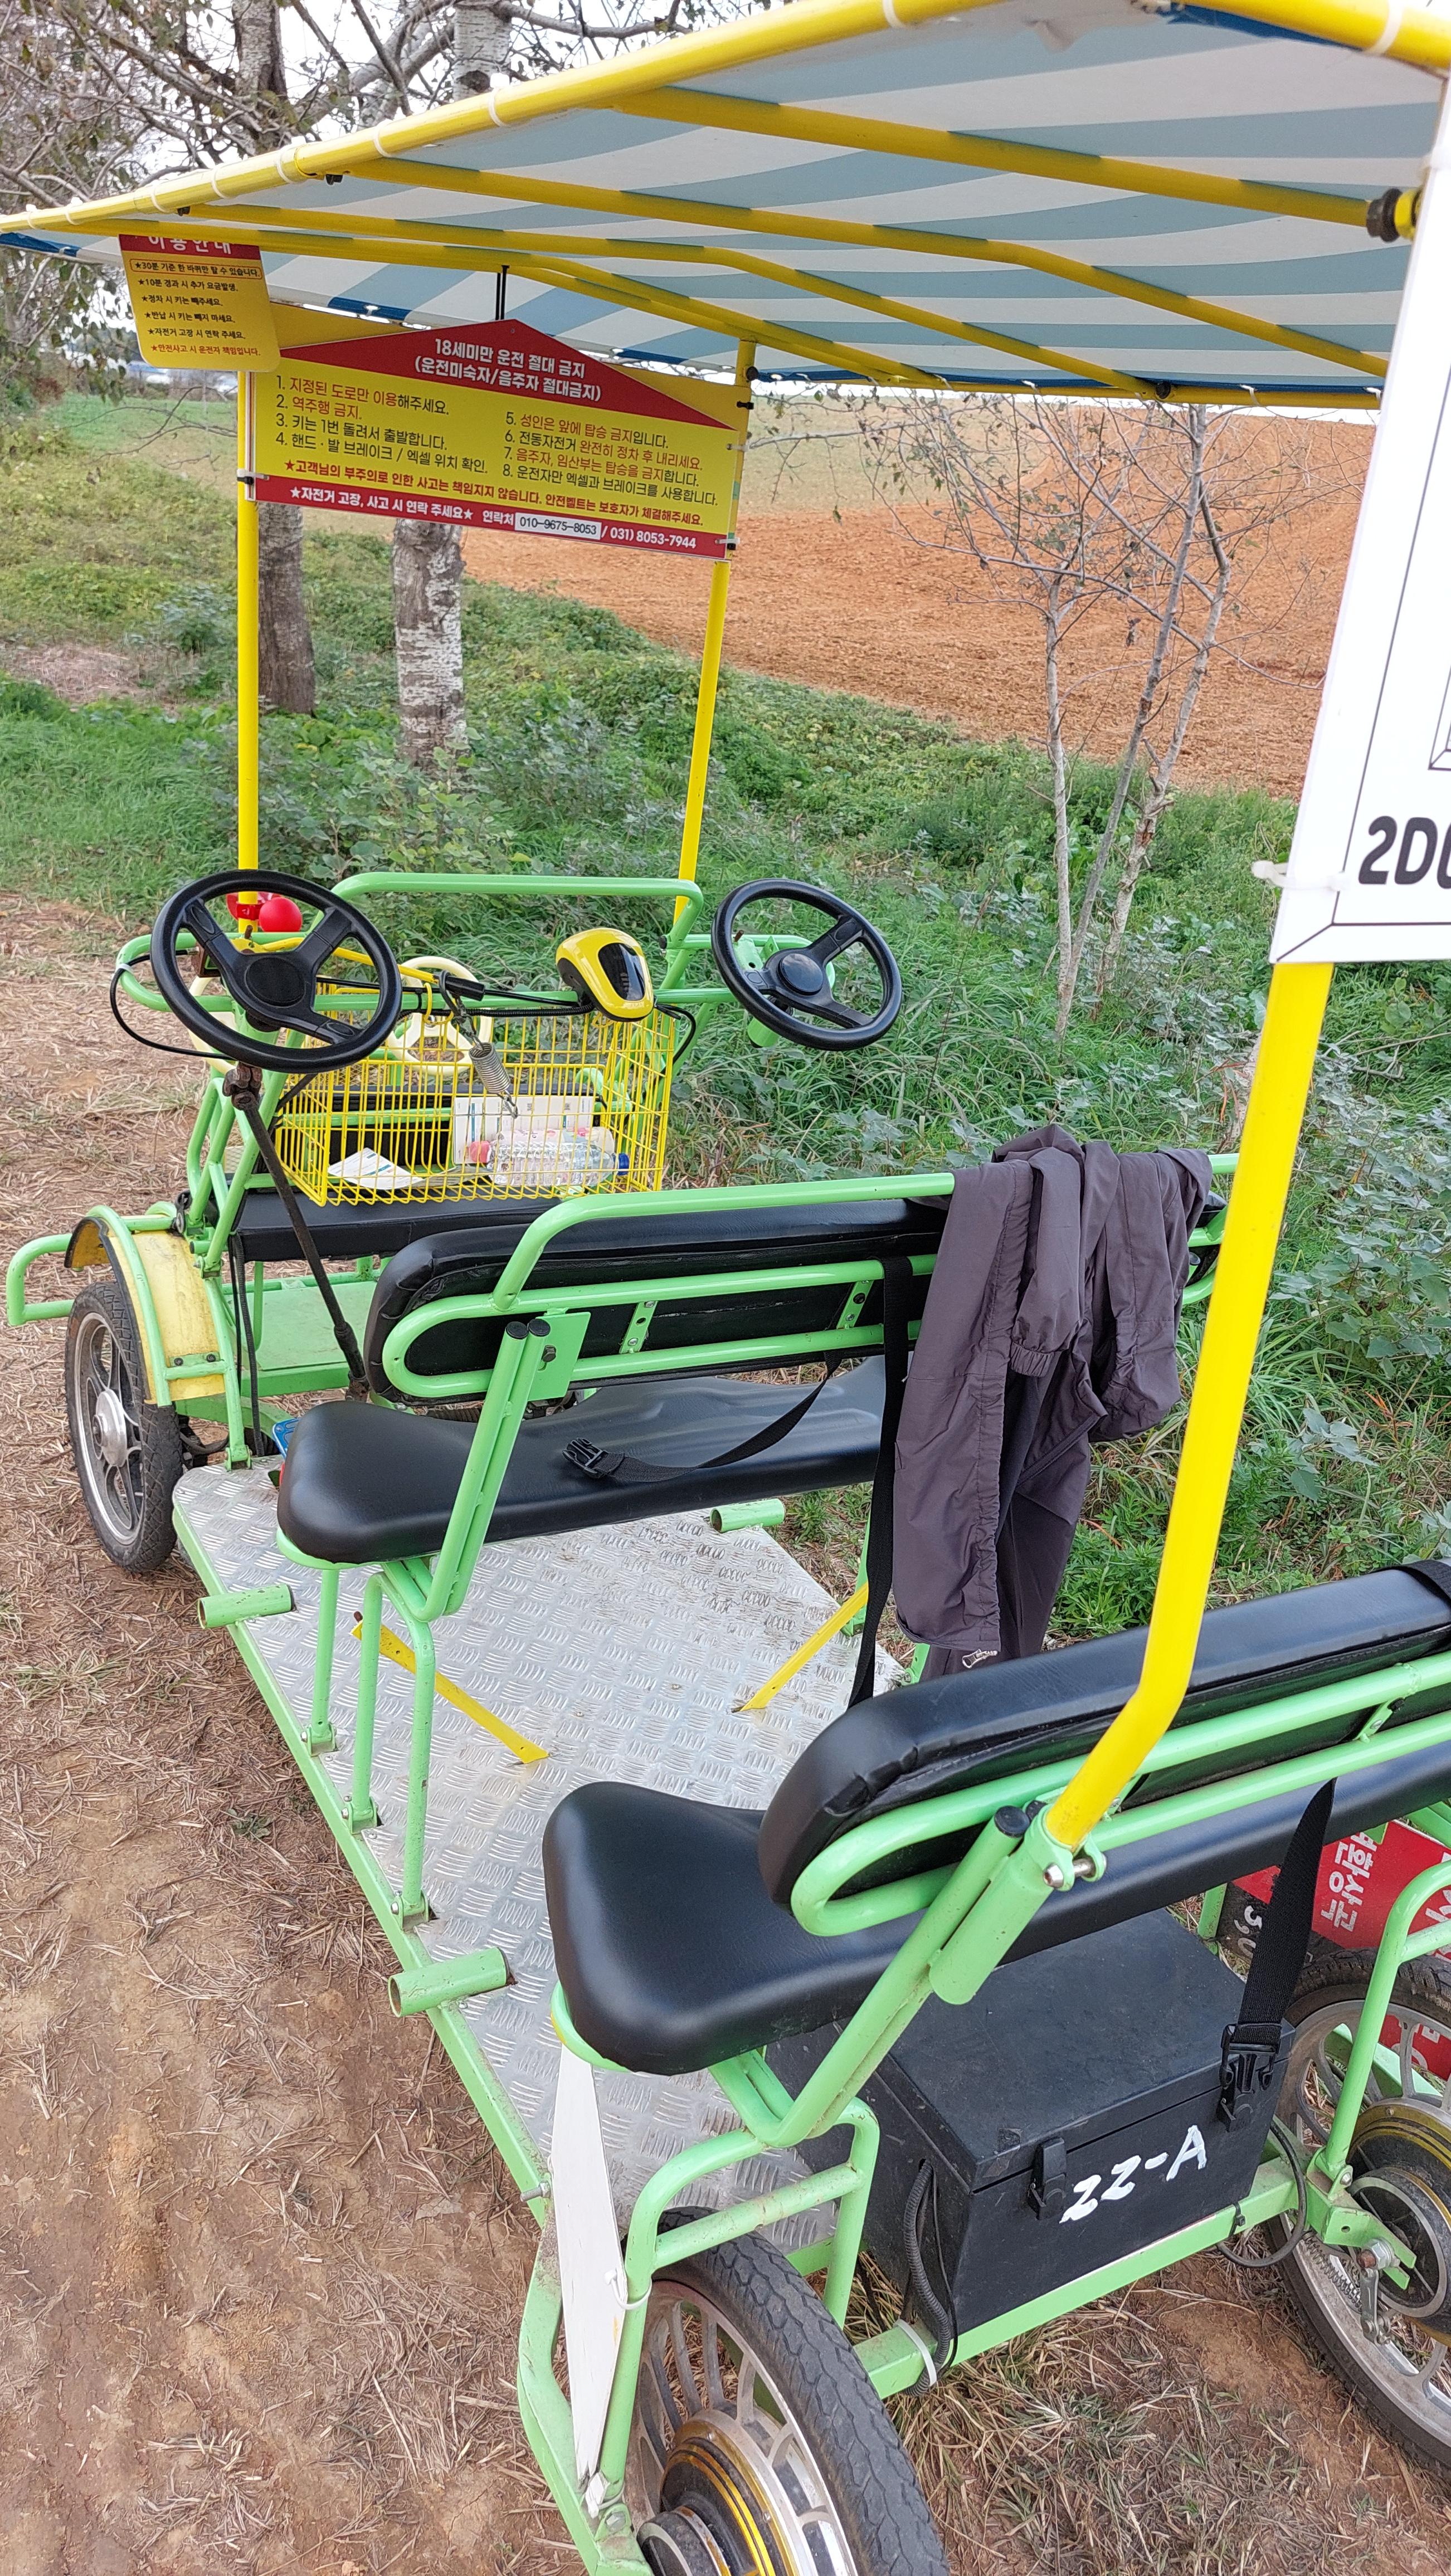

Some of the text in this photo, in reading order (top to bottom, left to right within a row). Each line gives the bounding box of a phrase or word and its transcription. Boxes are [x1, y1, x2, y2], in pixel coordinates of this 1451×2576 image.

[162, 264, 176, 272] 기준
[188, 265, 208, 274] 바퀴만
[230, 268, 260, 277] 있습니다.
[190, 281, 204, 290] 추가
[148, 295, 163, 304] 정차
[152, 311, 166, 320] 반납
[178, 313, 193, 321] 키는
[212, 314, 236, 323] 마세요.
[154, 328, 177, 337] 자전거
[179, 329, 193, 338] 고장
[204, 330, 219, 339] 연락
[222, 330, 246, 339] 주세요.
[158, 344, 188, 353] 안전사고
[190, 345, 197, 354] 시
[199, 346, 220, 354] 운전자
[435, 338, 585, 379] 18세미만 운전 절대 금지
[276, 375, 449, 415] 1. 지정된 도로만 이용해주세요.
[415, 355, 601, 402] (운전미숙자/음주자 절대금지)
[276, 394, 362, 420] 2. 역주행 금지.
[276, 413, 447, 451] 3. 키는 1번 돌려서 출발합니다.
[505, 411, 669, 450] 5. 성인은 앞에 탑승 금지입니다.
[276, 432, 288, 446] 4.
[291, 433, 317, 450] 핸드
[328, 438, 340, 453] 발
[343, 441, 393, 461] 브레이크
[407, 449, 431, 466] 엑셀
[434, 453, 458, 470] 위치
[462, 457, 488, 474] 확인.
[504, 446, 699, 487] 7. 음주자, 임산부는 탑승을 금지합니다.
[505, 430, 703, 471] 6. 전동자전거 완전히 정차 후 내리세요.
[295, 460, 703, 526] 고객님의 부주의로 인한 사고는 책임지지 않습니다. 안전벨트는 보호자가 체결해주세요.
[503, 464, 718, 506] 8. 운전자만 엑셀과 브레이크를 사용합니다.
[300, 486, 335, 504] 자전거
[338, 491, 364, 508] 고장,
[367, 495, 389, 510] 사고
[392, 499, 403, 513] 시
[406, 500, 428, 515] 연락
[482, 510, 514, 526] 연락처
[519, 516, 597, 535] 010-9675-8053
[610, 527, 634, 541] 031)
[636, 531, 696, 549] 8053-7944
